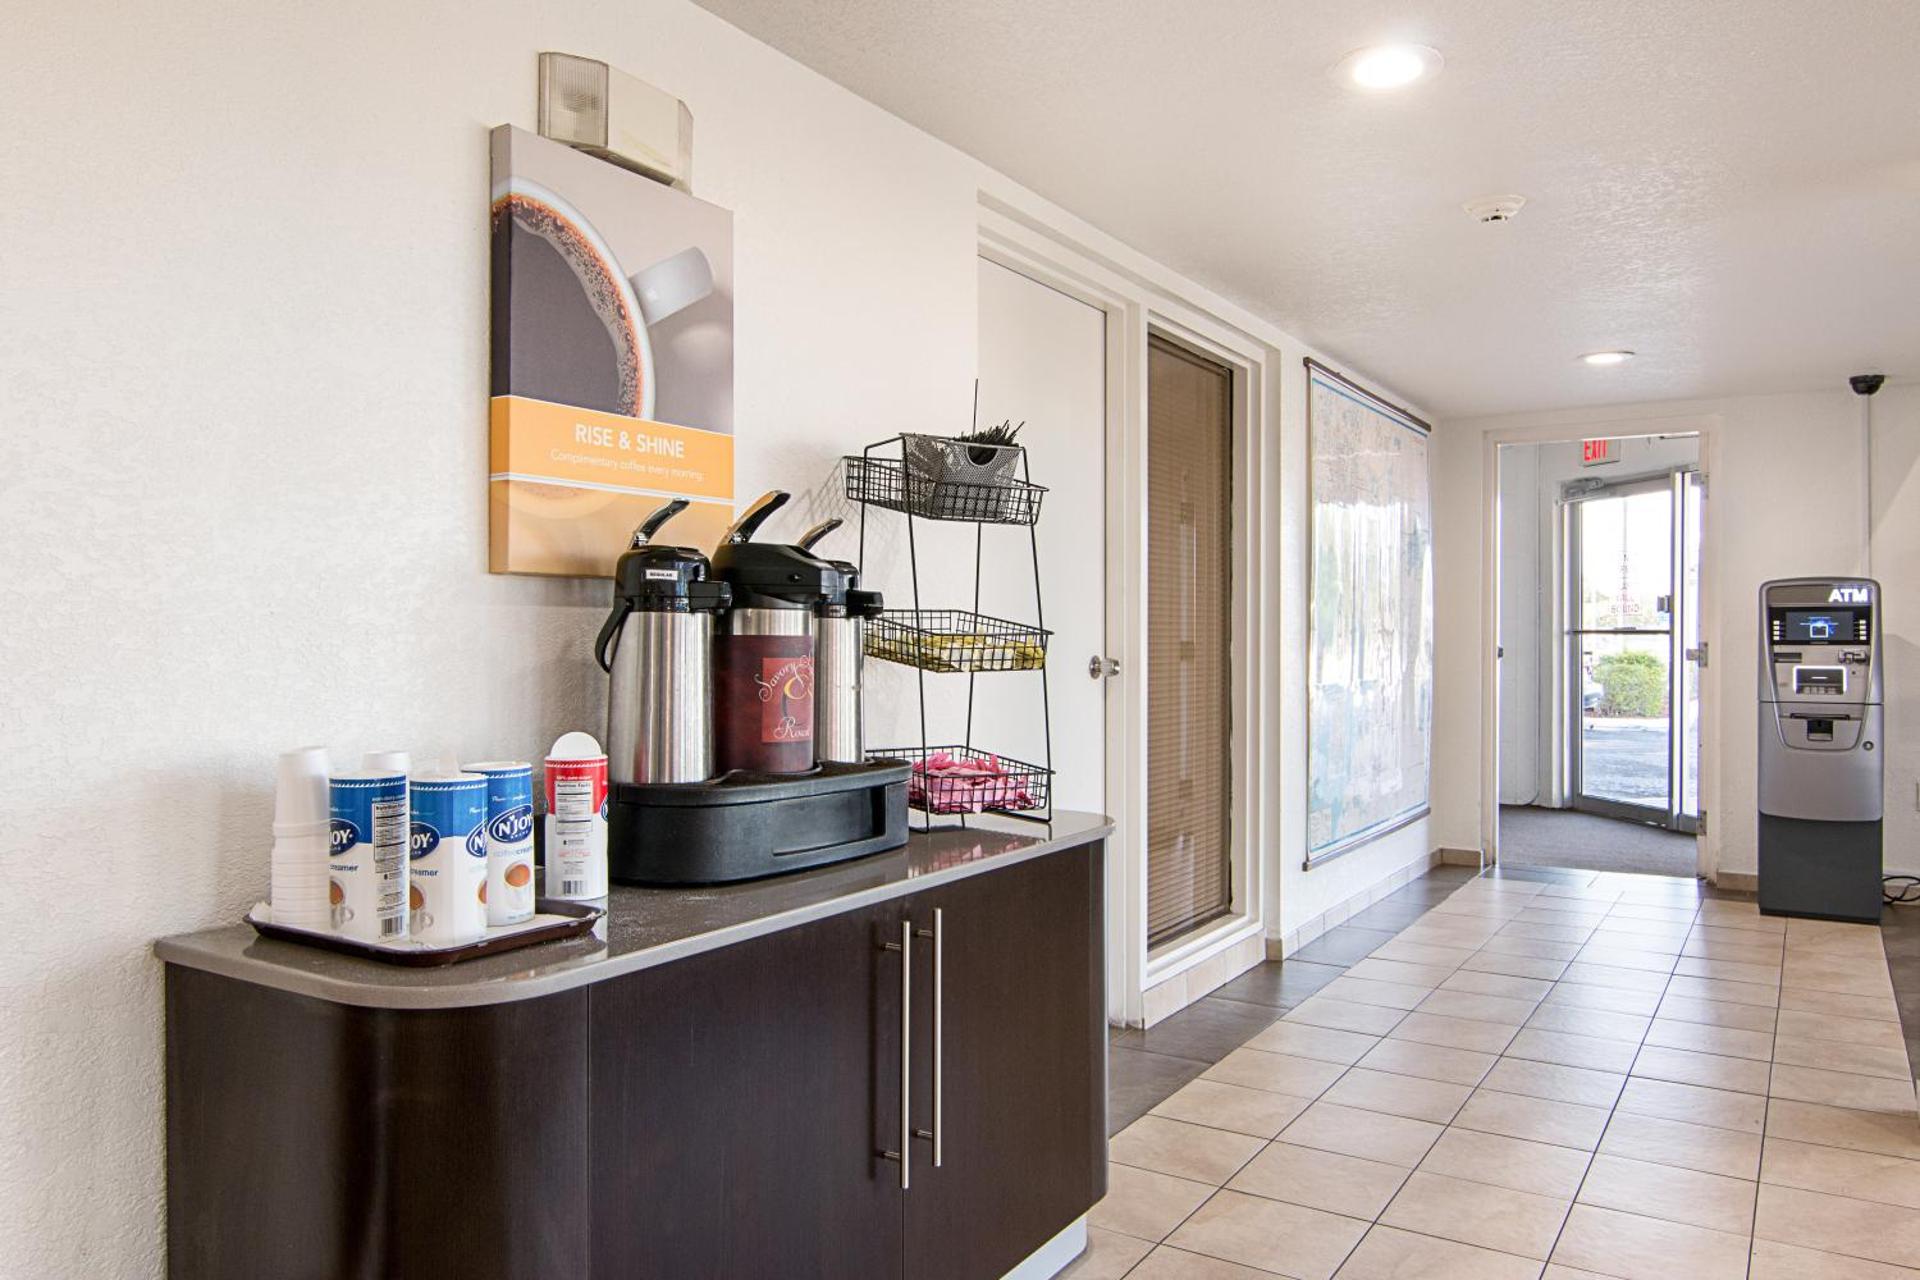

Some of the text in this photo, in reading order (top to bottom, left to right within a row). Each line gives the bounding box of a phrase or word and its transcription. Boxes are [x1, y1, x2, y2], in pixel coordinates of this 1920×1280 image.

[574, 423, 685, 458] RISE & SHINE
[1583, 440, 1608, 461] EXIT
[551, 448, 618, 470] Complimentary
[620, 460, 646, 473] coffee
[648, 464, 669, 477] every
[1827, 588, 1869, 603] ATM
